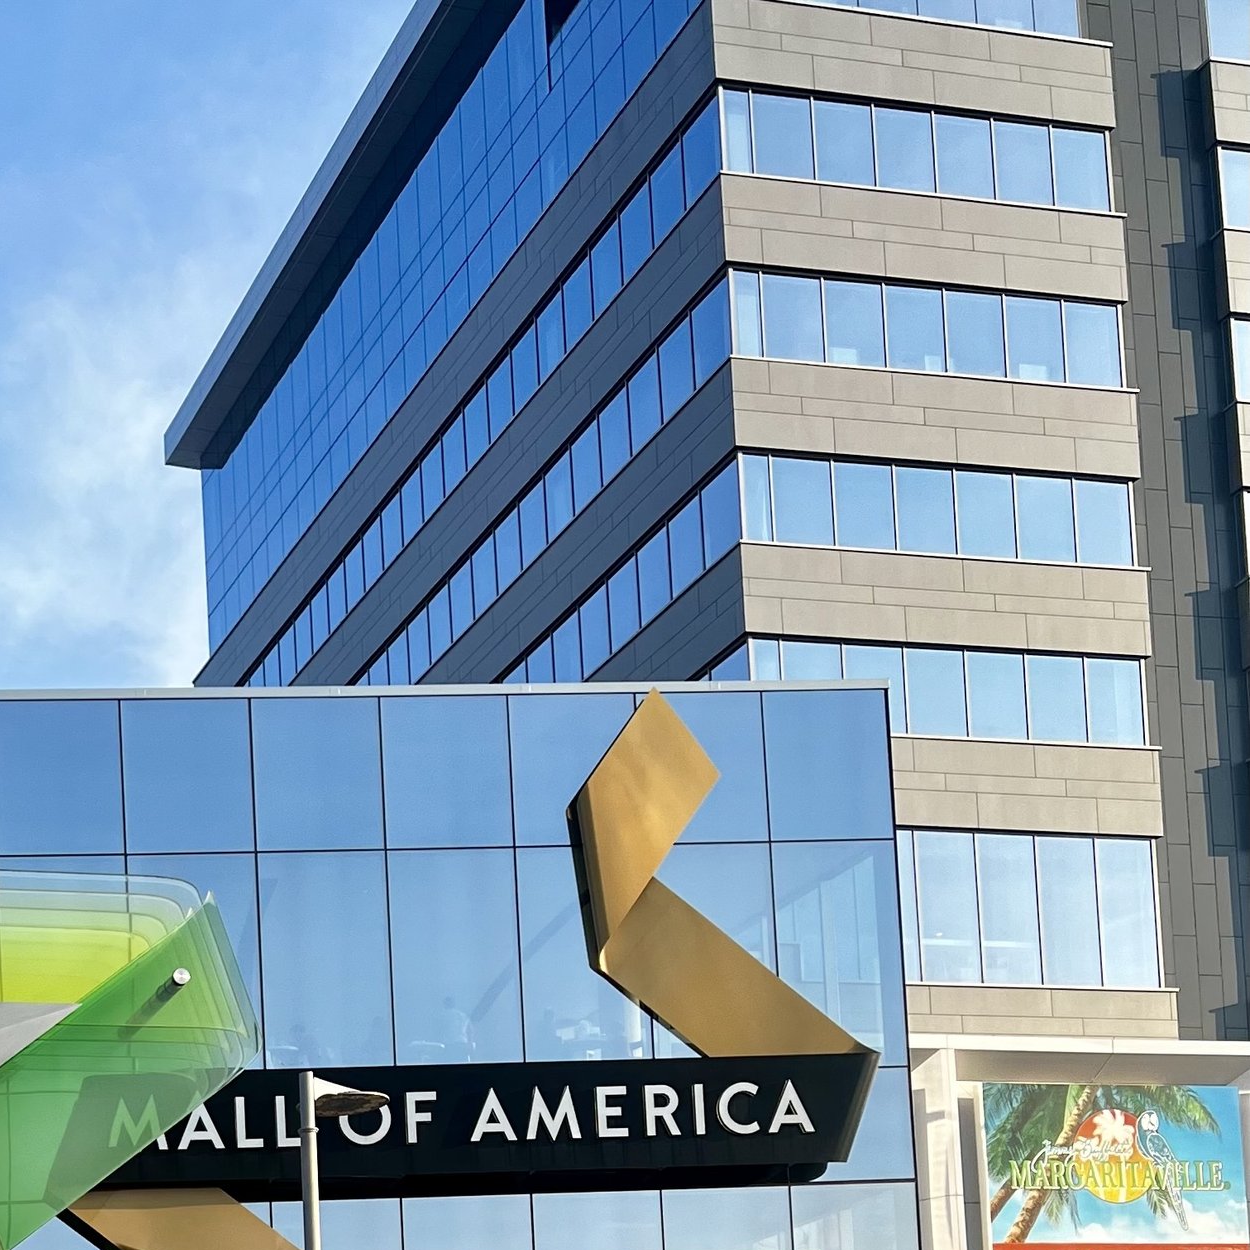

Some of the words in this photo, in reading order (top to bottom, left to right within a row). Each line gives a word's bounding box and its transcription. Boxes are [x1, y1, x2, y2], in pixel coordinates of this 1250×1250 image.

[108, 1091, 302, 1150] MALL
[338, 1090, 438, 1146] OF
[469, 1078, 817, 1142] AMERICA
[1008, 1159, 1225, 1191] MARGARITAVILLE
